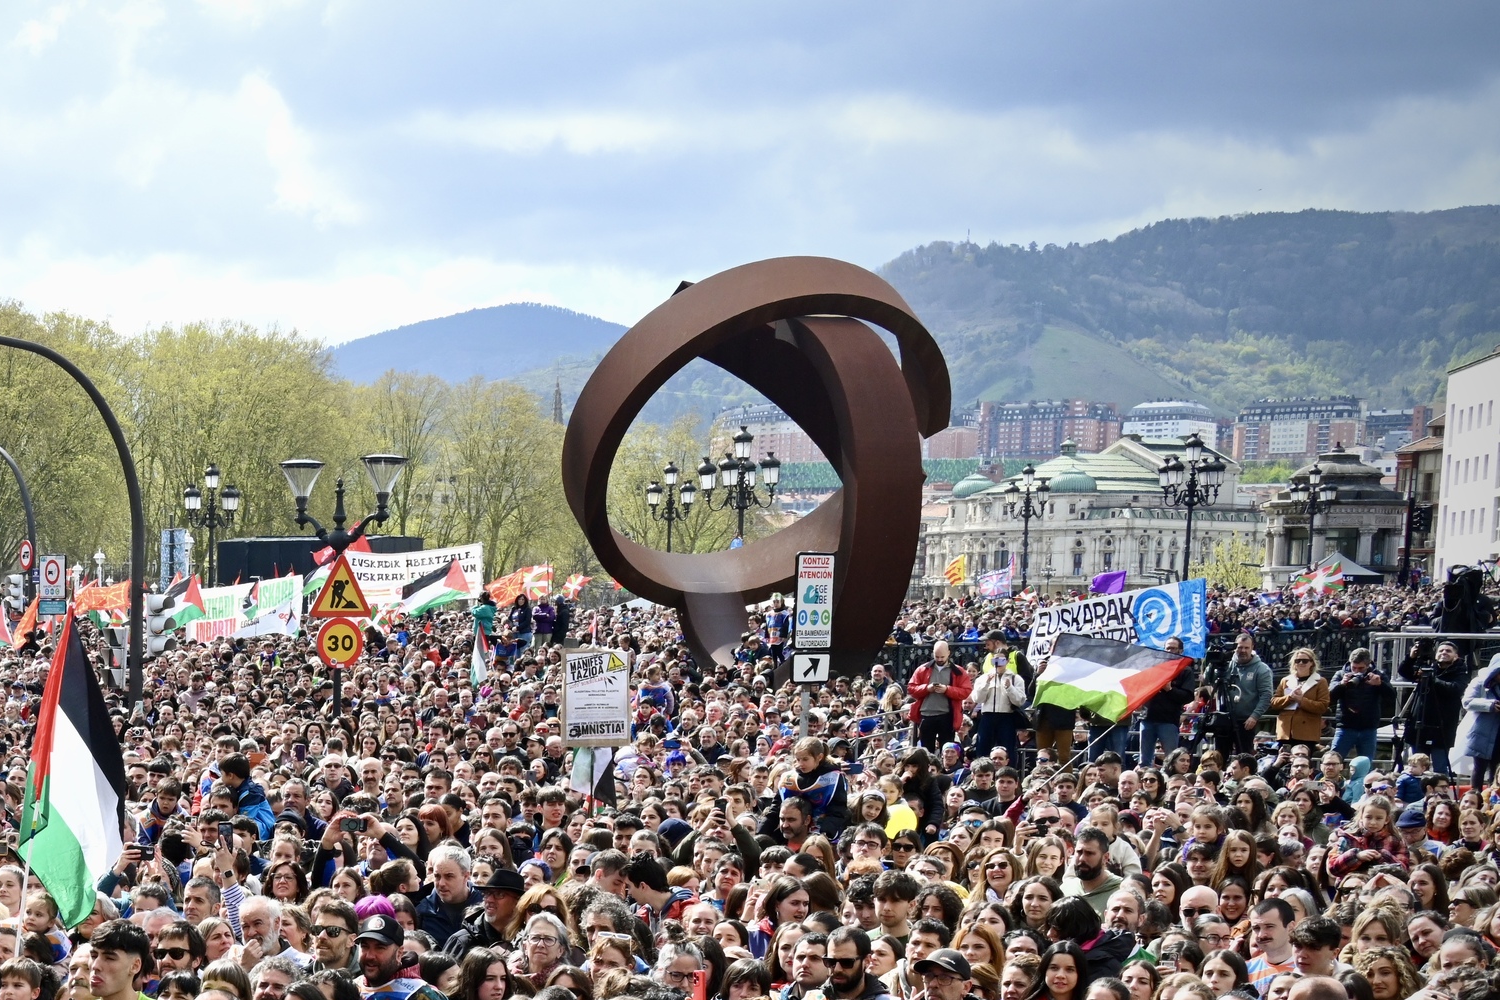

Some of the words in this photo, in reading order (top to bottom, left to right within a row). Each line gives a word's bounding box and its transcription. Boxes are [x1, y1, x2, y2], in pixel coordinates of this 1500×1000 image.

[802, 557, 830, 565] KONTUZ
[799, 569, 833, 579] ATENCIÓN
[815, 585, 828, 593] EGE
[814, 595, 828, 604] ZBE
[1035, 595, 1135, 637] EUSKARAK
[327, 634, 354, 652] 30
[569, 656, 604, 672] MANIFES
[570, 665, 604, 681] TAZIOA
